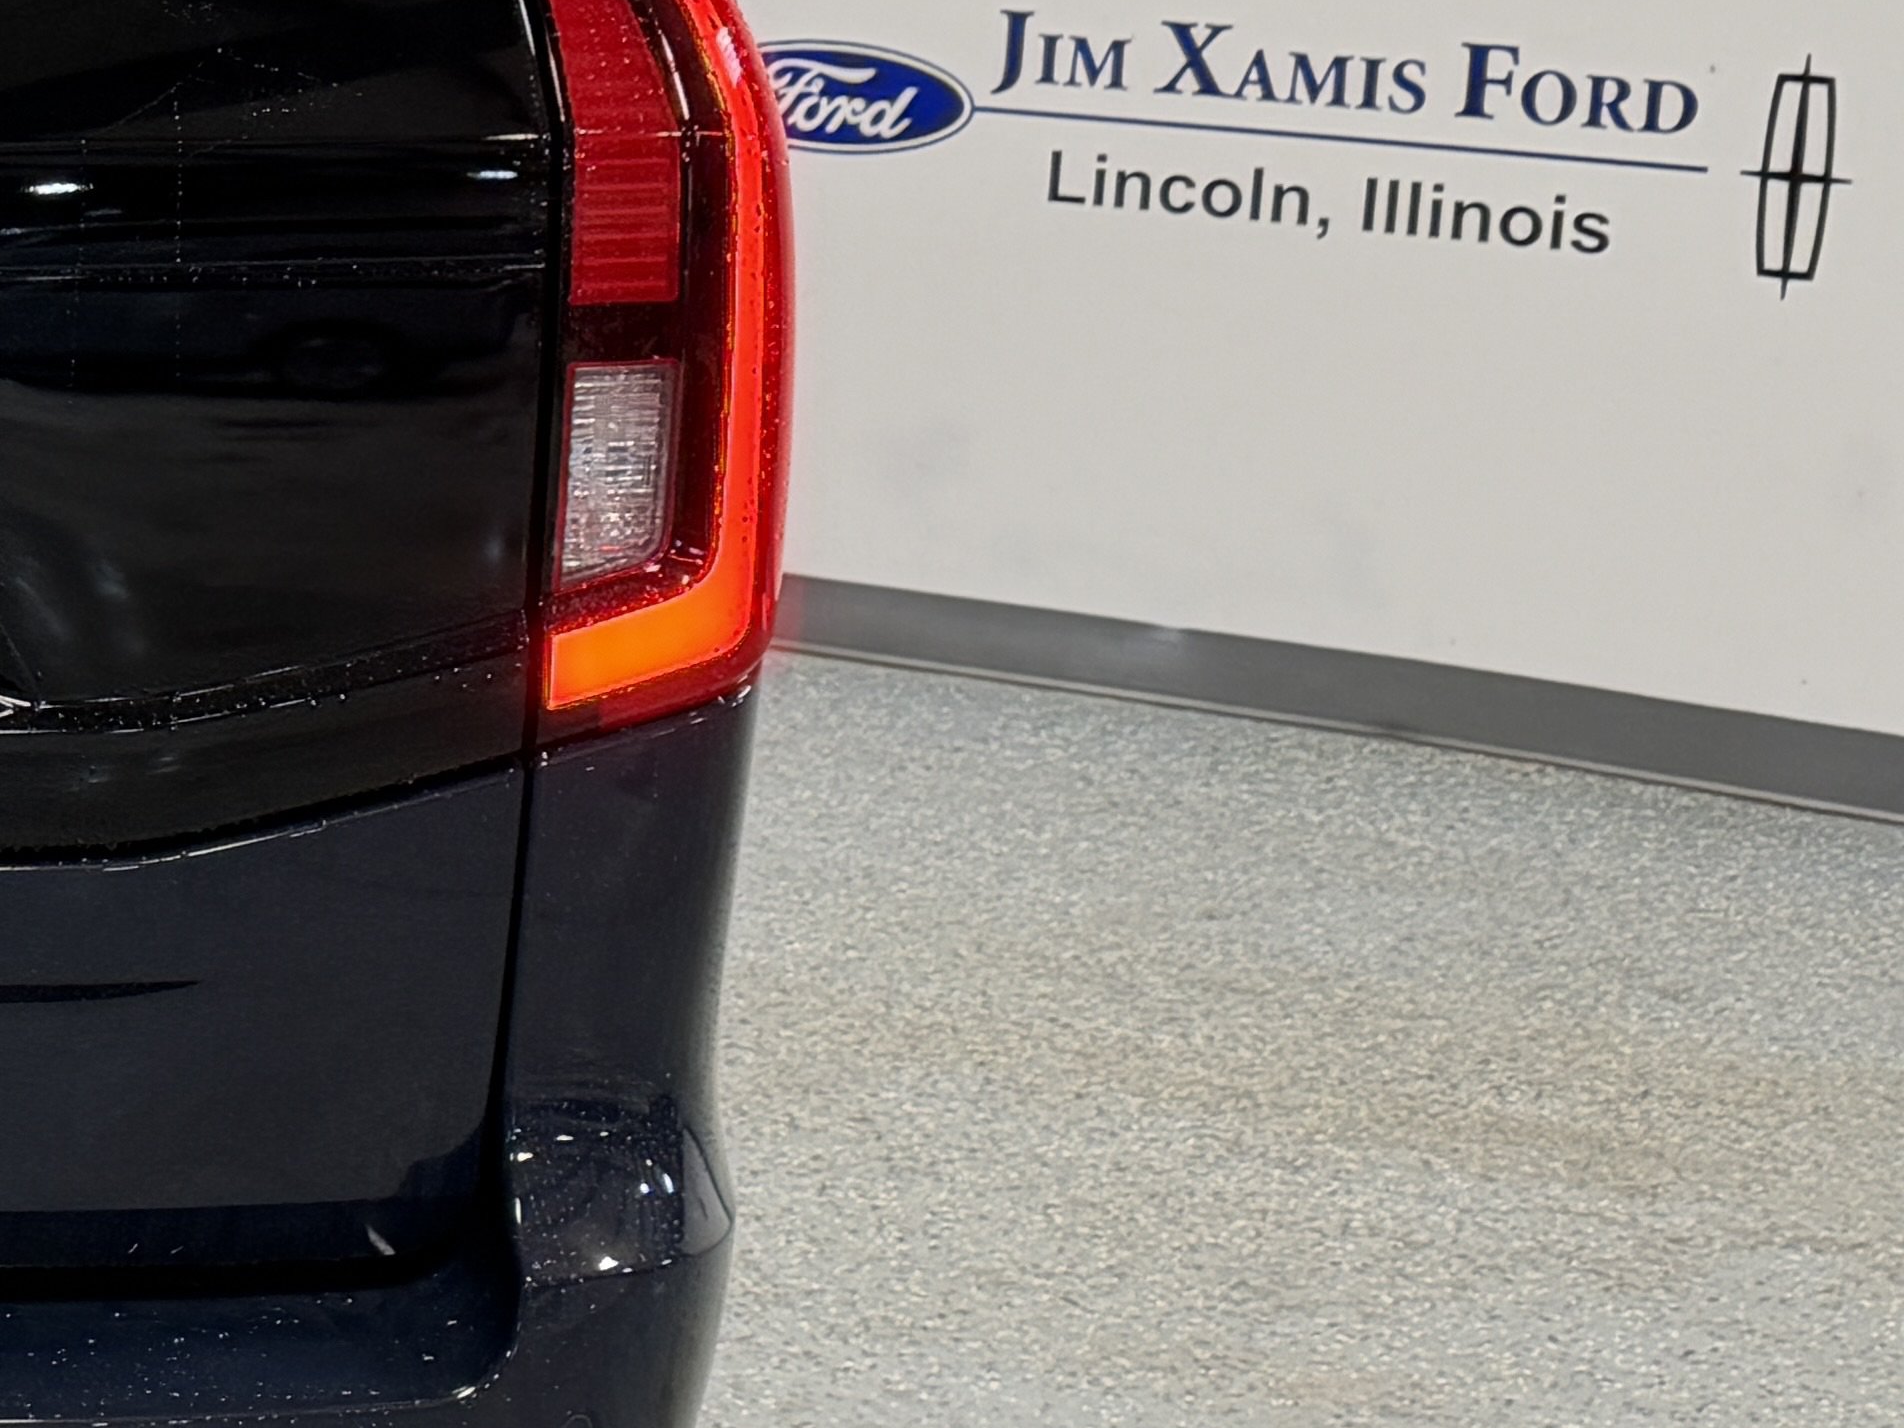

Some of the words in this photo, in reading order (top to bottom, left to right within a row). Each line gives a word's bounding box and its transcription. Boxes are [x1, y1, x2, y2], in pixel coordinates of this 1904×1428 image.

[767, 57, 920, 140] Ford
[1045, 148, 1331, 241] Lincoln,
[1359, 175, 1612, 256] Illinois
